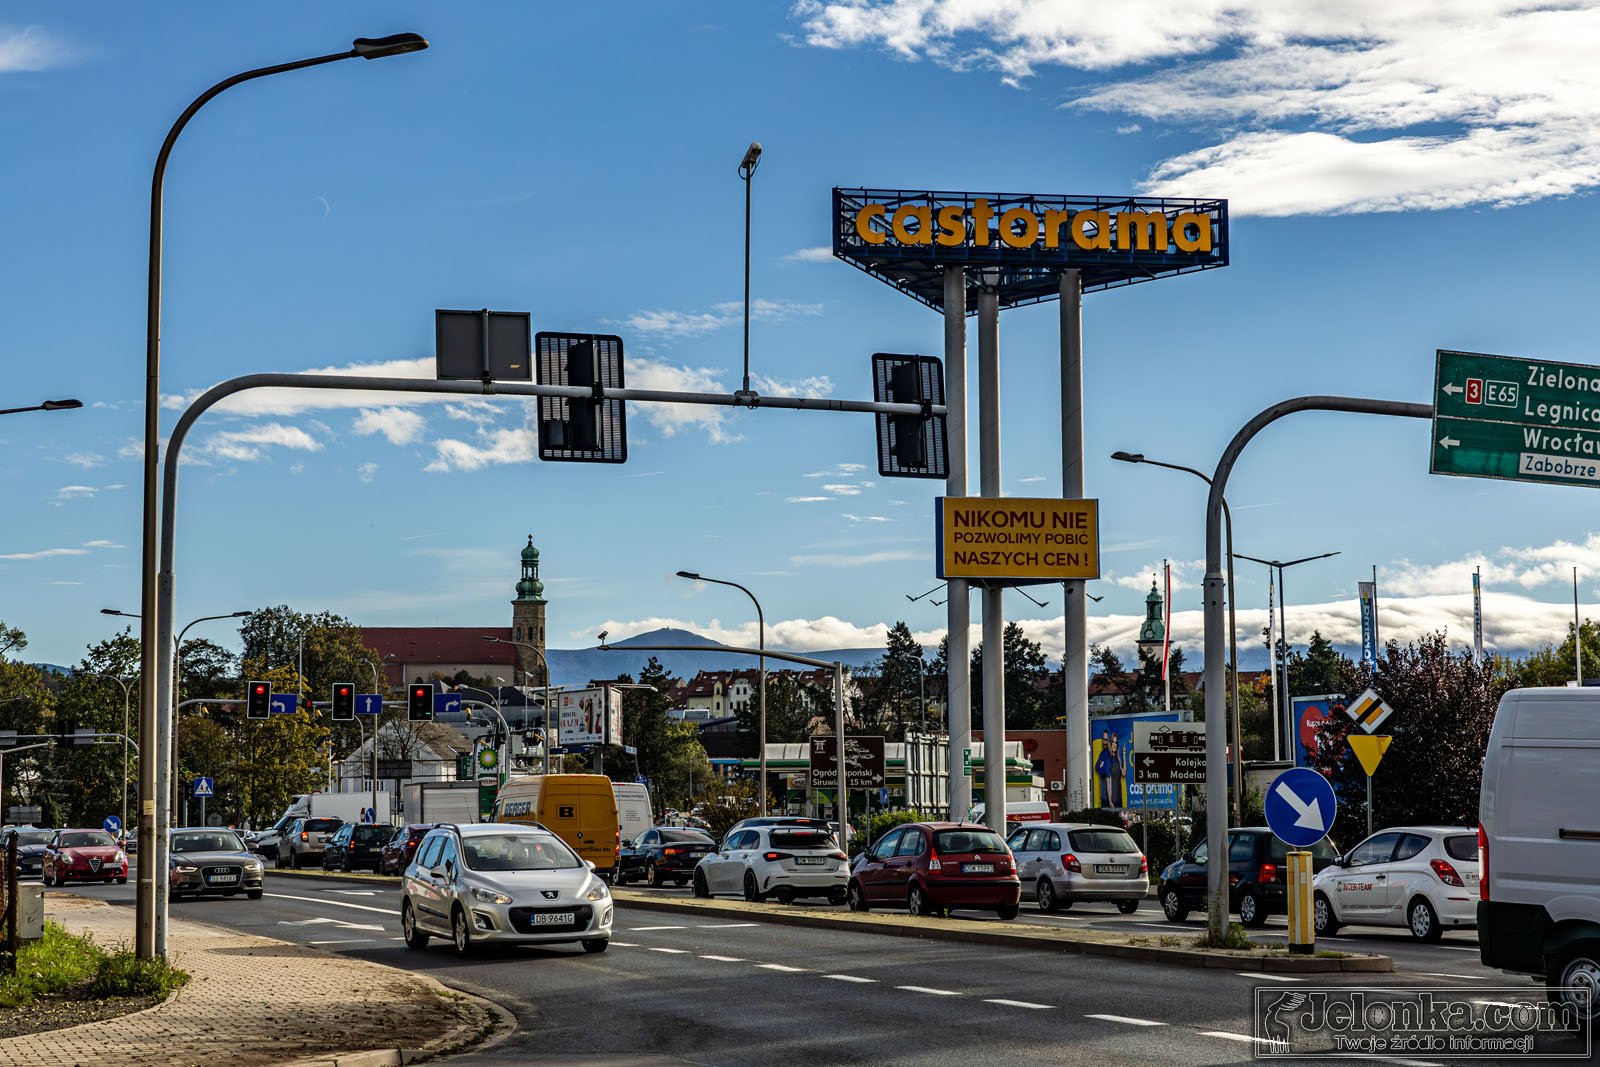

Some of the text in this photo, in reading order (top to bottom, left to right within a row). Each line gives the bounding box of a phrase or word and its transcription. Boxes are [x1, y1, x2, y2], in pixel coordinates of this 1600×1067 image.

[856, 198, 1211, 252] castorama
[1528, 366, 1600, 392] Zielona
[1470, 383, 1516, 402] 3 E65
[1524, 428, 1600, 454] Wrocła
[1525, 455, 1596, 477] Zabobrze
[954, 510, 1088, 529] NIKOMU NIE
[954, 530, 1089, 545] POZWOLIMY POBIĆ
[954, 551, 1039, 566] NASZYCH
[1044, 552, 1079, 566] CEN
[1175, 758, 1207, 768] Kolejko
[812, 769, 837, 778] Ogród
[1139, 770, 1207, 779] 3 km Modelar
[504, 801, 531, 817] BERGER
[559, 806, 574, 818] B
[1343, 882, 1372, 891] INTER-TEAM
[535, 914, 573, 923] DB 9641G
